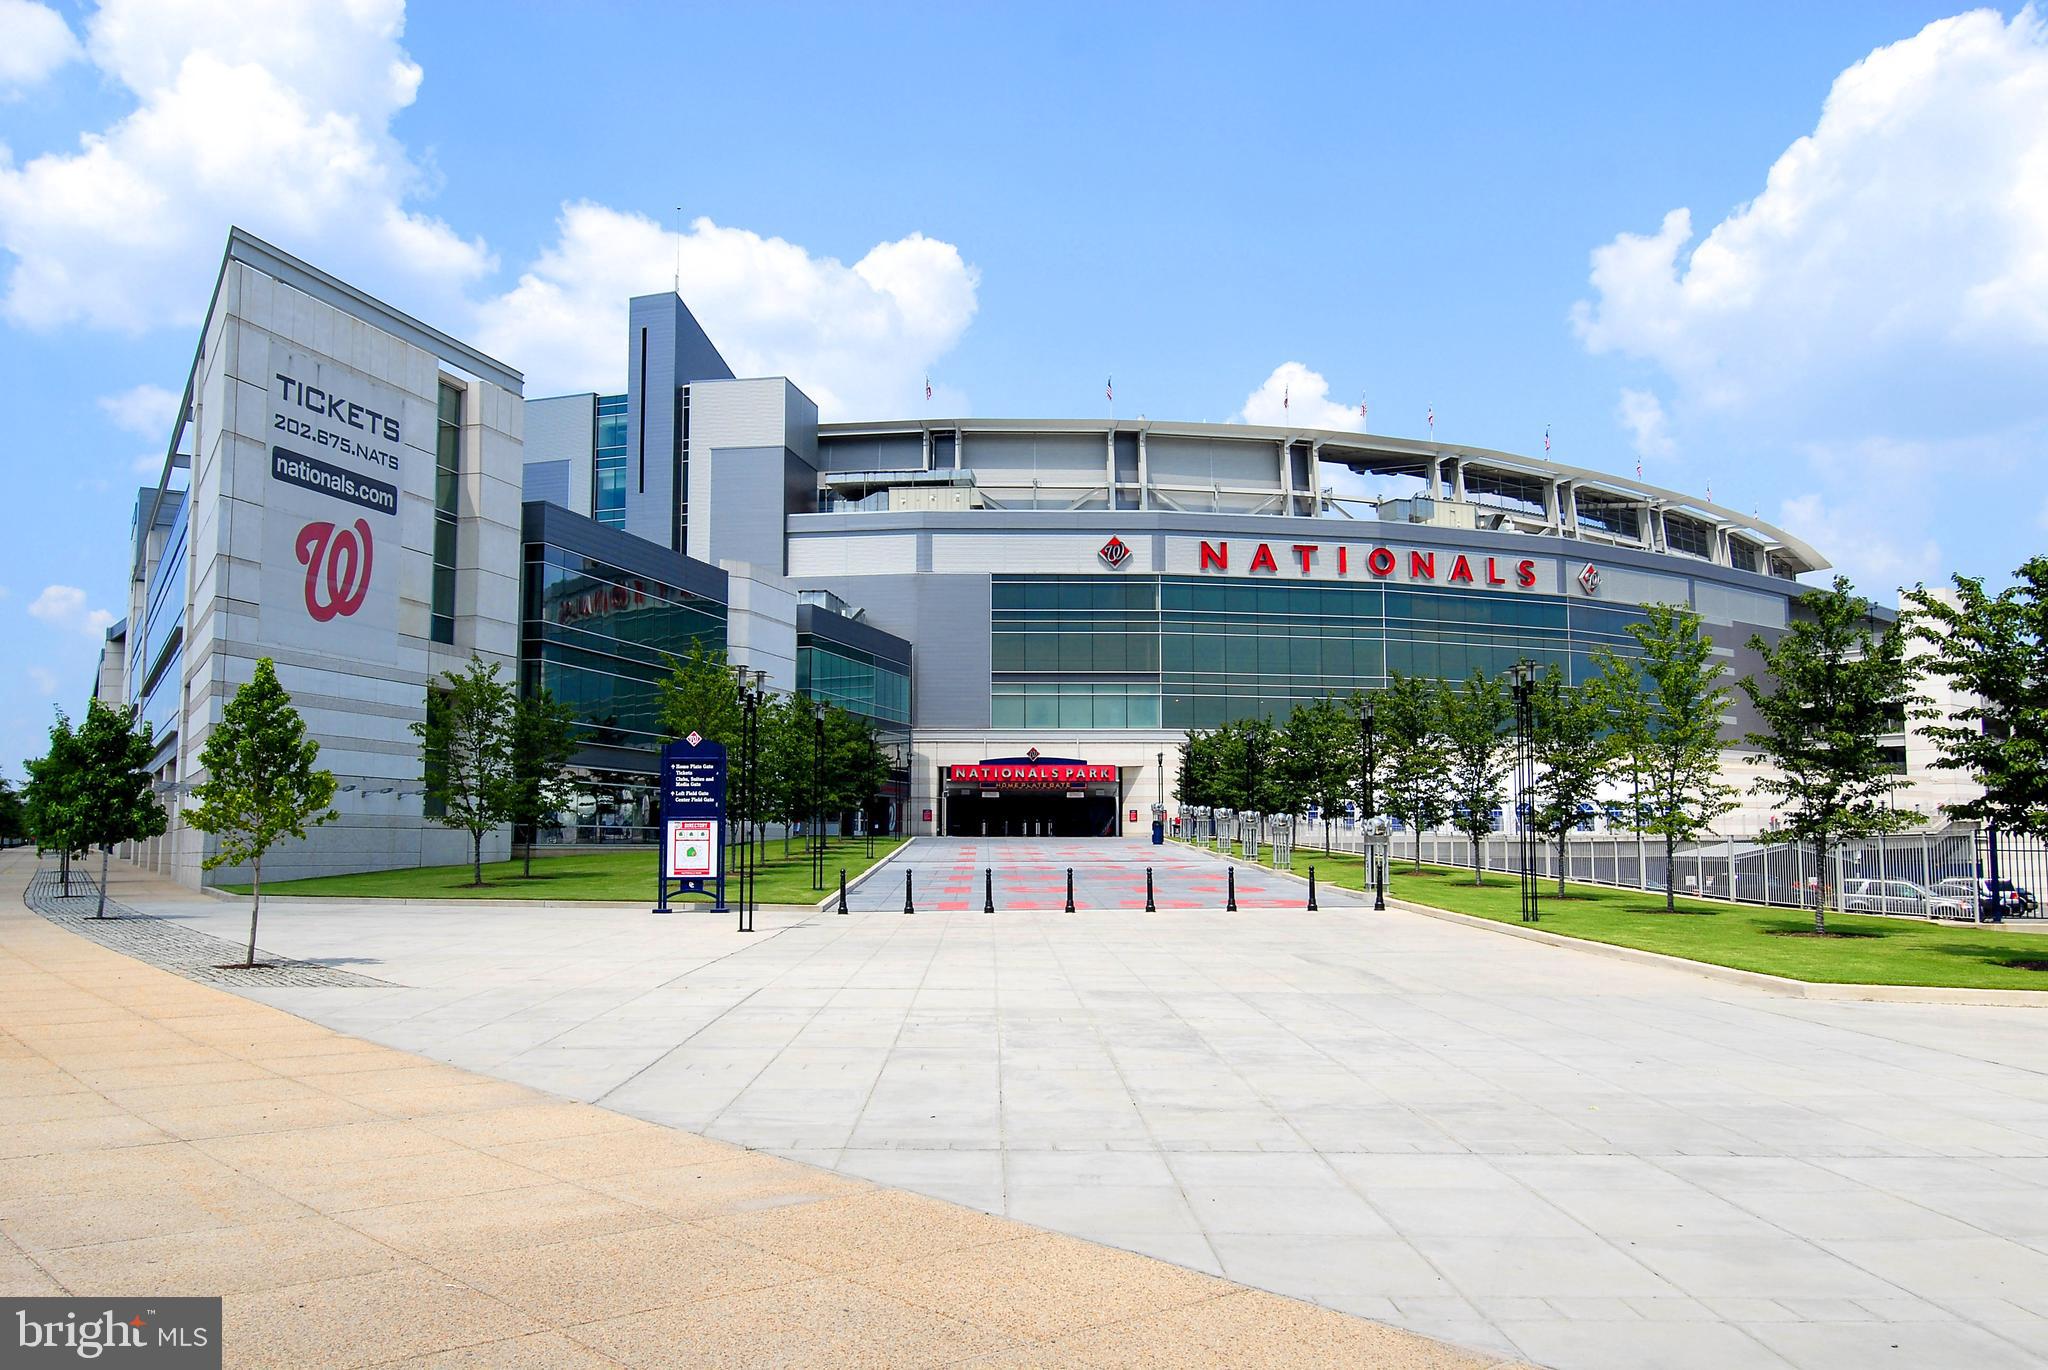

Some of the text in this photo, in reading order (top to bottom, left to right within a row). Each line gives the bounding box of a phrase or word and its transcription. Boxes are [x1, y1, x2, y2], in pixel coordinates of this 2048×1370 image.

[276, 373, 400, 443] TICKETS
[274, 413, 399, 471] 202.675.NATS
[276, 457, 393, 508] nationals.com
[295, 518, 374, 622] W
[1200, 541, 1536, 587] NATIONALS
[955, 768, 1110, 778] NATIONALS PARK
